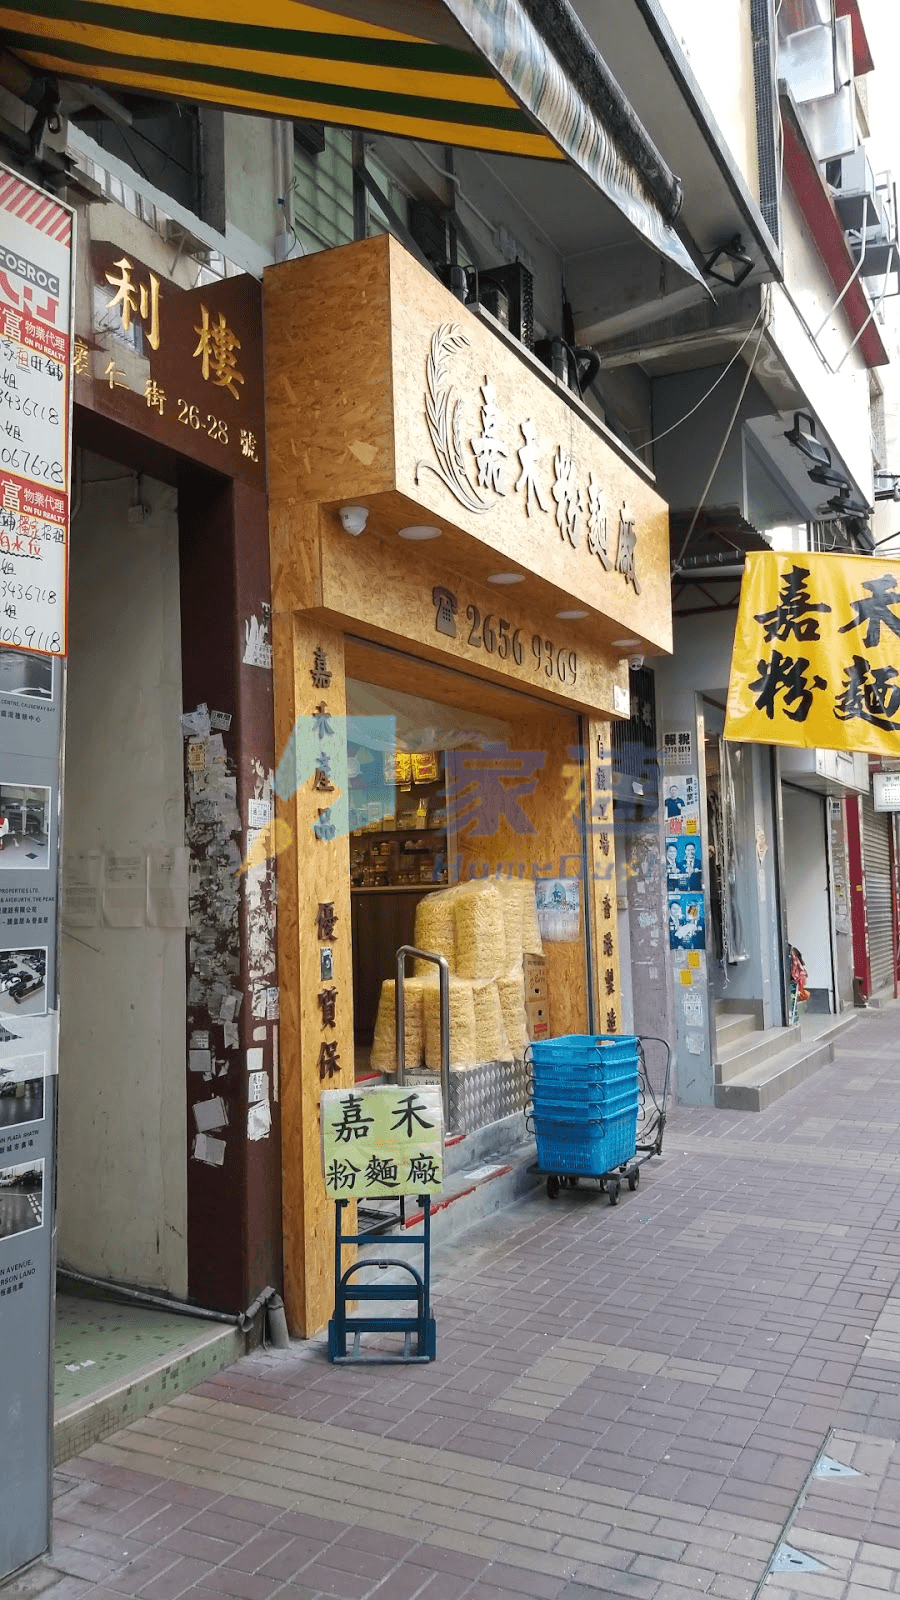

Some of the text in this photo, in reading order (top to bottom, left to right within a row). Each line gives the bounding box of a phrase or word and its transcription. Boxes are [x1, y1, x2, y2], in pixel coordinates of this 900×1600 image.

[24, 337, 66, 362] ON FU REALTY
[25, 320, 66, 352] 物業代理
[24, 487, 65, 514] 物業代理
[468, 374, 642, 596] 嘉禾粉麵廠
[23, 504, 66, 524] ON FU REALTY
[466, 604, 578, 686] 2656 9369
[331, 1093, 435, 1143] 嘉禾
[326, 1152, 442, 1191] 粉麵廠
